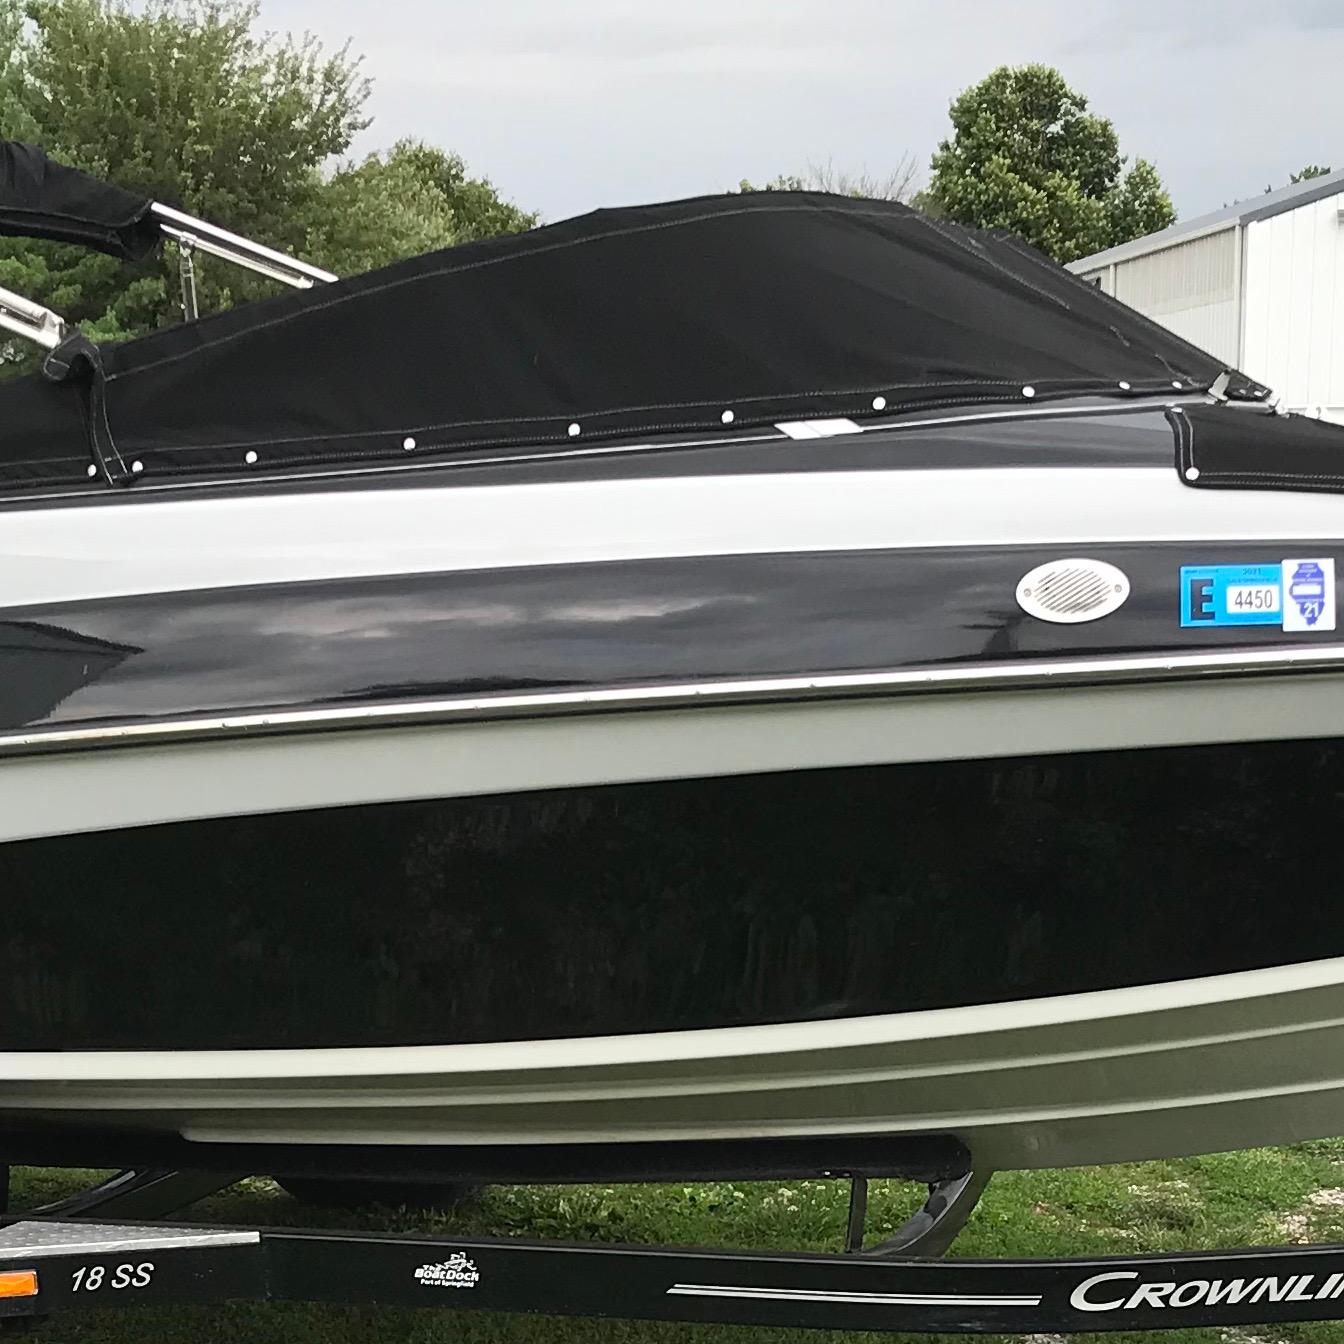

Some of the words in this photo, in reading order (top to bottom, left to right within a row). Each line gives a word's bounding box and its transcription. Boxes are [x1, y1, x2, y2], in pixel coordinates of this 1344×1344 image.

[1190, 578, 1216, 621] E
[1234, 589, 1273, 609] 4450
[1303, 602, 1320, 618] 21
[72, 1266, 105, 1292] 18
[111, 1262, 155, 1288] SS
